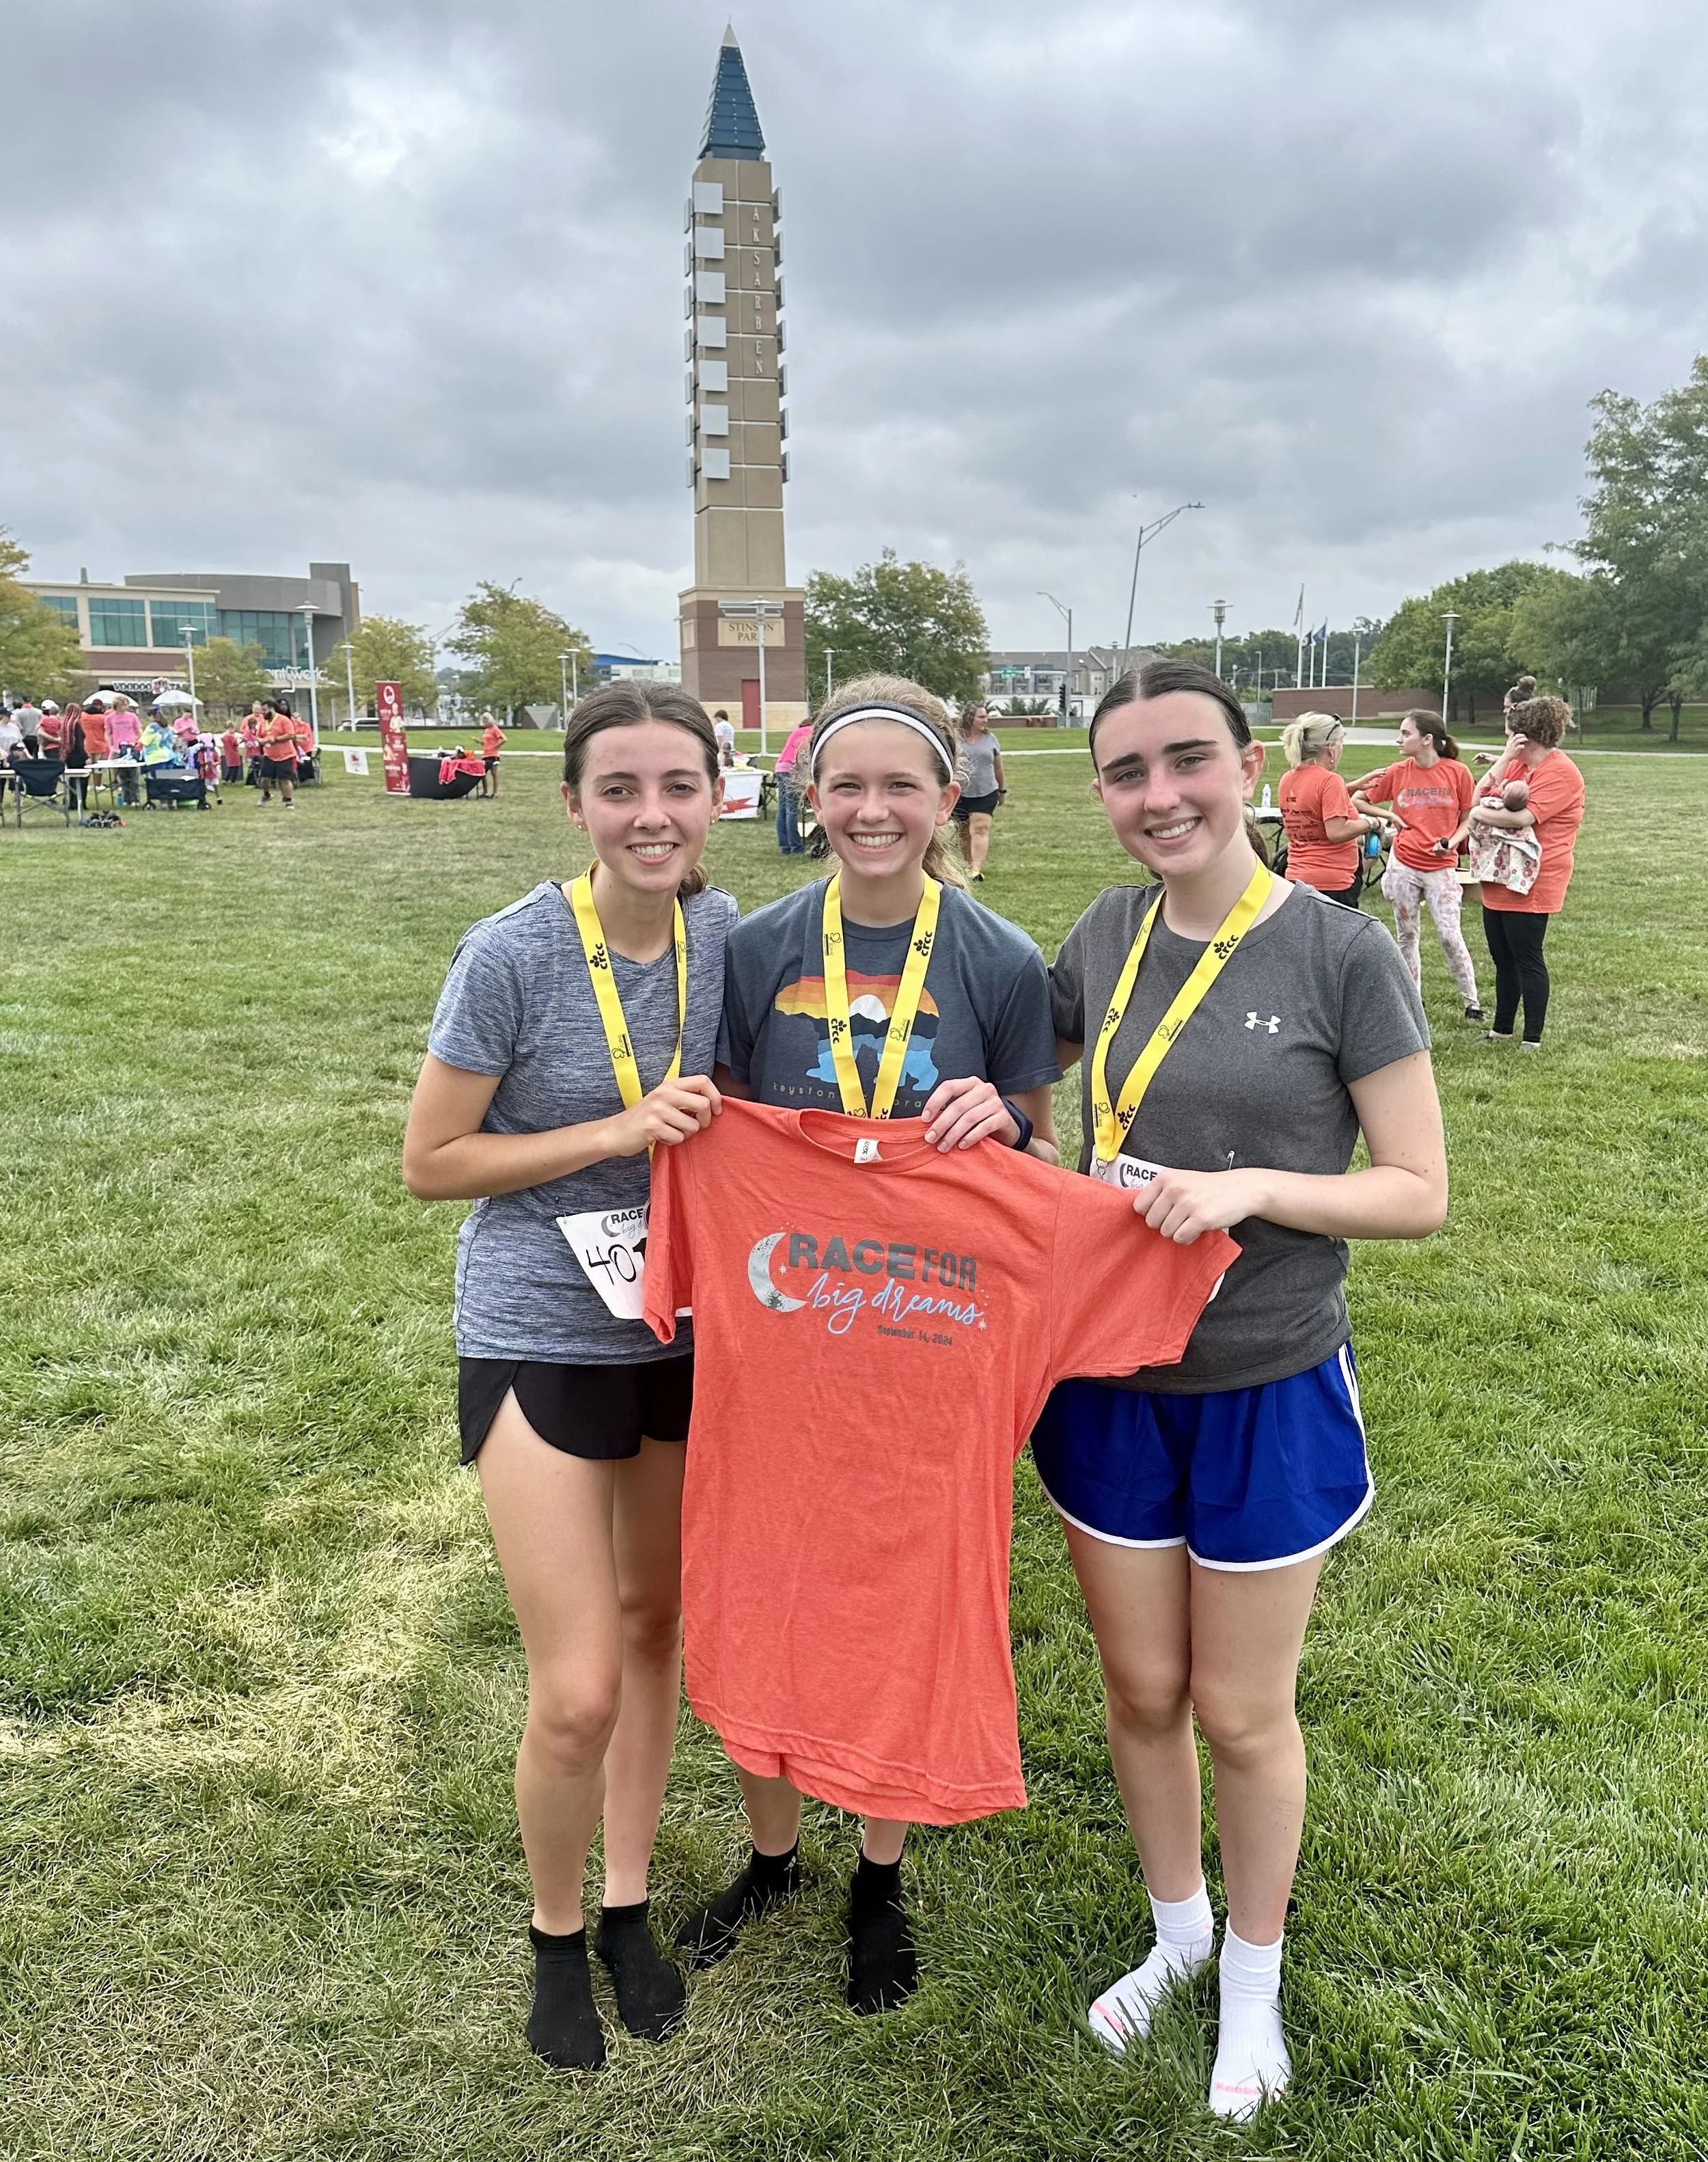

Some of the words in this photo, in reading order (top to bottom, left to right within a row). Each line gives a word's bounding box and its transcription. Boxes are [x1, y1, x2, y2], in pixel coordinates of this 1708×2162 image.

[753, 206, 763, 374] AKSARBEN
[738, 632, 765, 641] PAR
[113, 682, 152, 692] VOODOO
[595, 942, 608, 970] crcc
[922, 931, 933, 957] crcc
[1218, 934, 1239, 960] crcc
[831, 1018, 840, 1044] crcc
[773, 1082, 835, 1099] keyston
[1122, 1104, 1135, 1131] crcc
[611, 1207, 644, 1224] RACE
[620, 1222, 637, 1240] big
[788, 1233, 917, 1280] RACE
[922, 1248, 977, 1291] FOR
[806, 1272, 868, 1335] big
[871, 1278, 984, 1326] dreams
